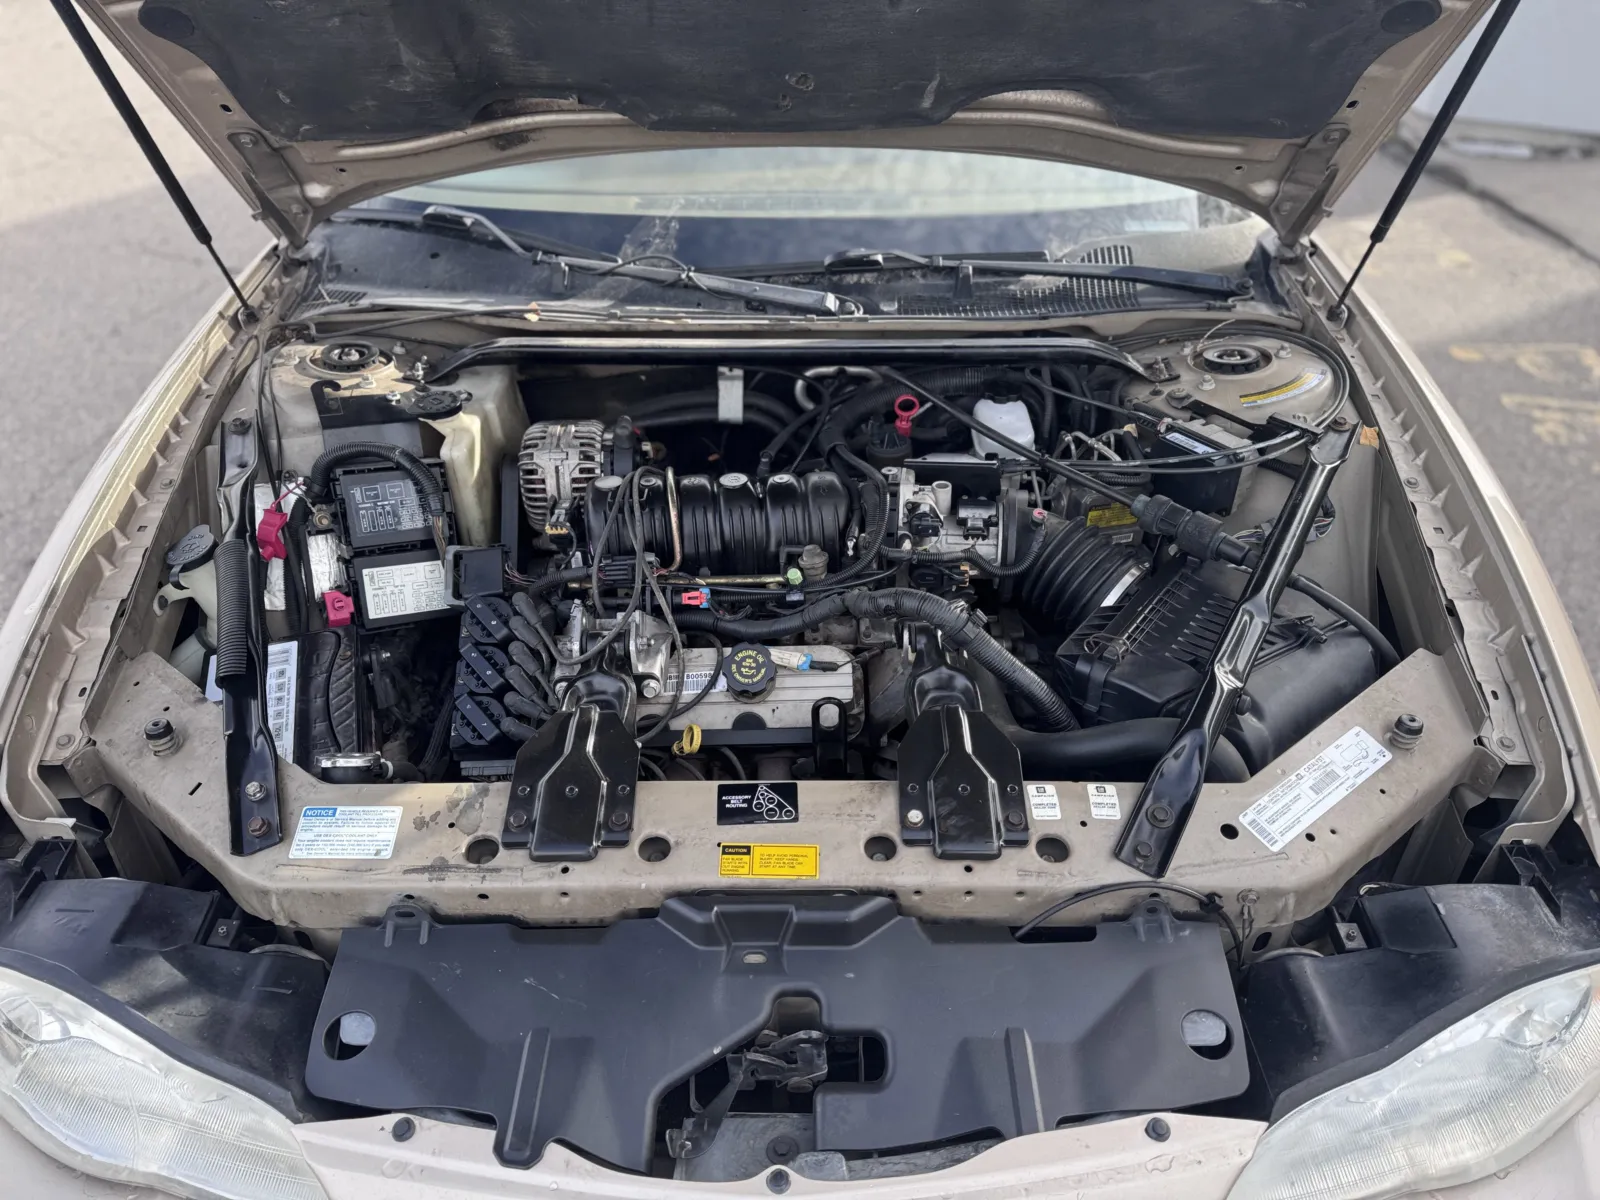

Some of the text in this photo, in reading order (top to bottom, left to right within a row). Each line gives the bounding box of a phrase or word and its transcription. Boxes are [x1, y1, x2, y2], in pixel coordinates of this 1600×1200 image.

[734, 649, 765, 664] ENGINE OIL
[752, 667, 766, 682] MANUAL
[1303, 755, 1325, 773] CATALYST
